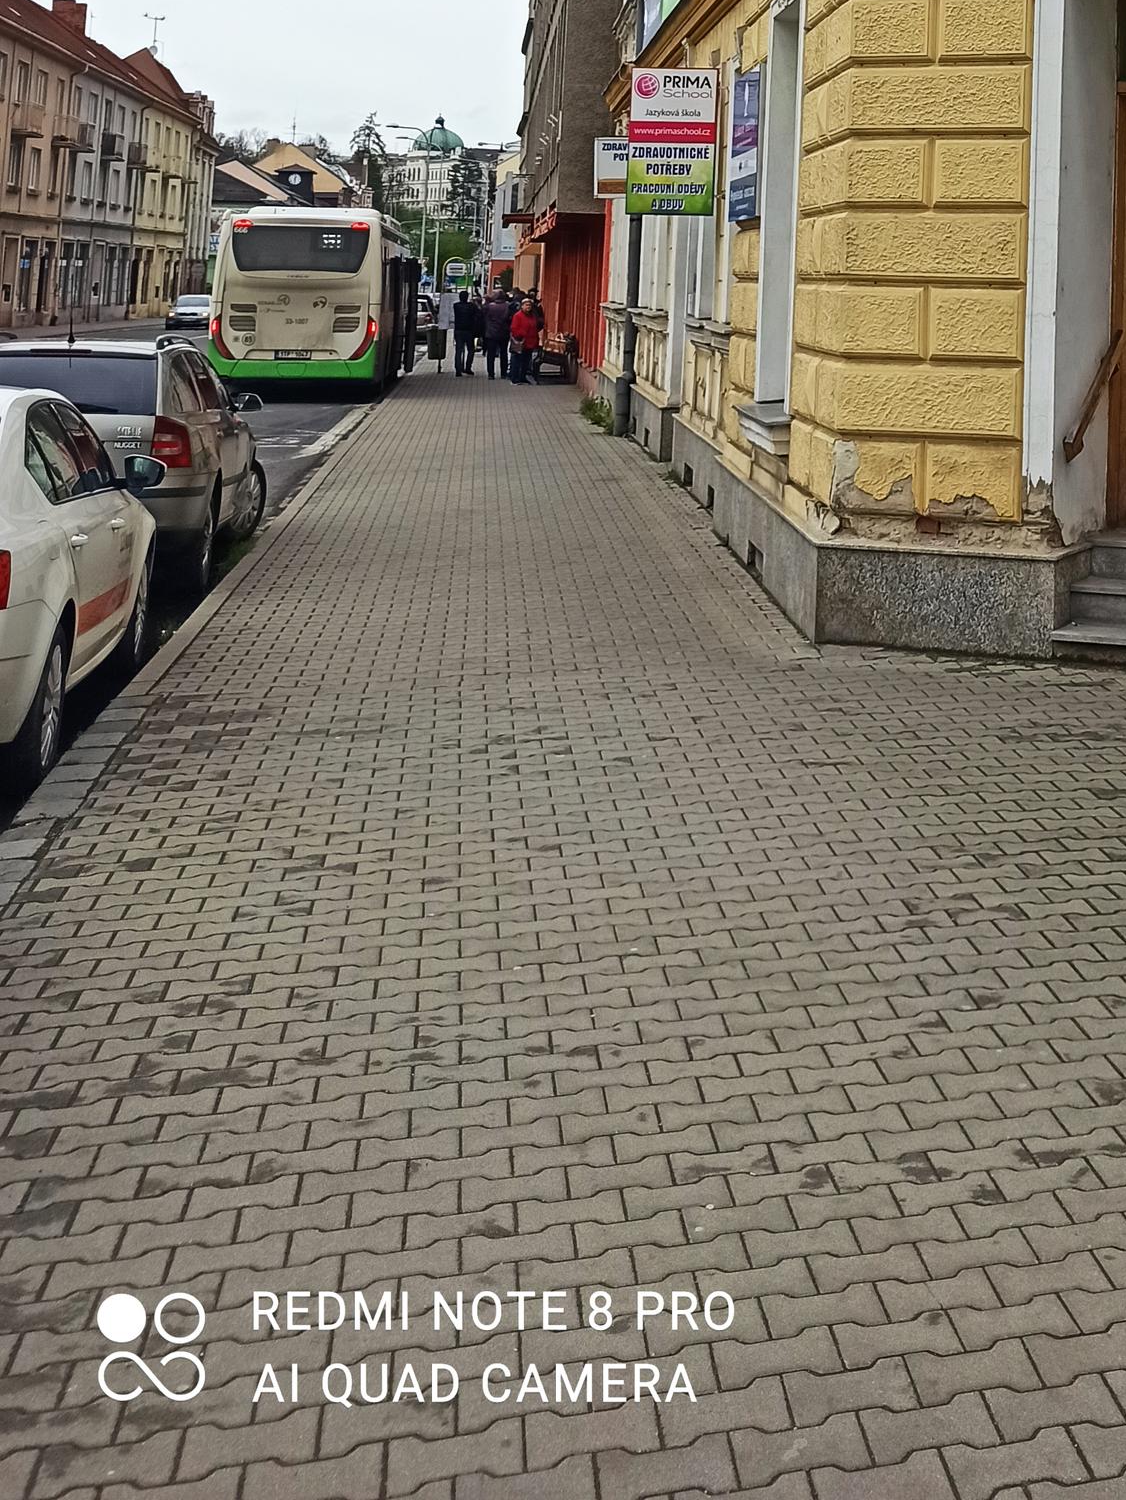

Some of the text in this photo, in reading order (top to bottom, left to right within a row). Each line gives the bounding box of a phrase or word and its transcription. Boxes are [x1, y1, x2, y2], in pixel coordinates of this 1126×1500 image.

[663, 75, 712, 89] PRIMA
[663, 88, 713, 99] School
[645, 108, 701, 118] Jazyková škola
[634, 127, 711, 136] www.primaschool.cz
[631, 145, 710, 160] ZDRAVOTNICKÉ
[646, 161, 692, 176] POTŘEBY
[631, 182, 706, 195] PRACOVNÍ ODĚVY
[651, 199, 685, 210] A OBUV
